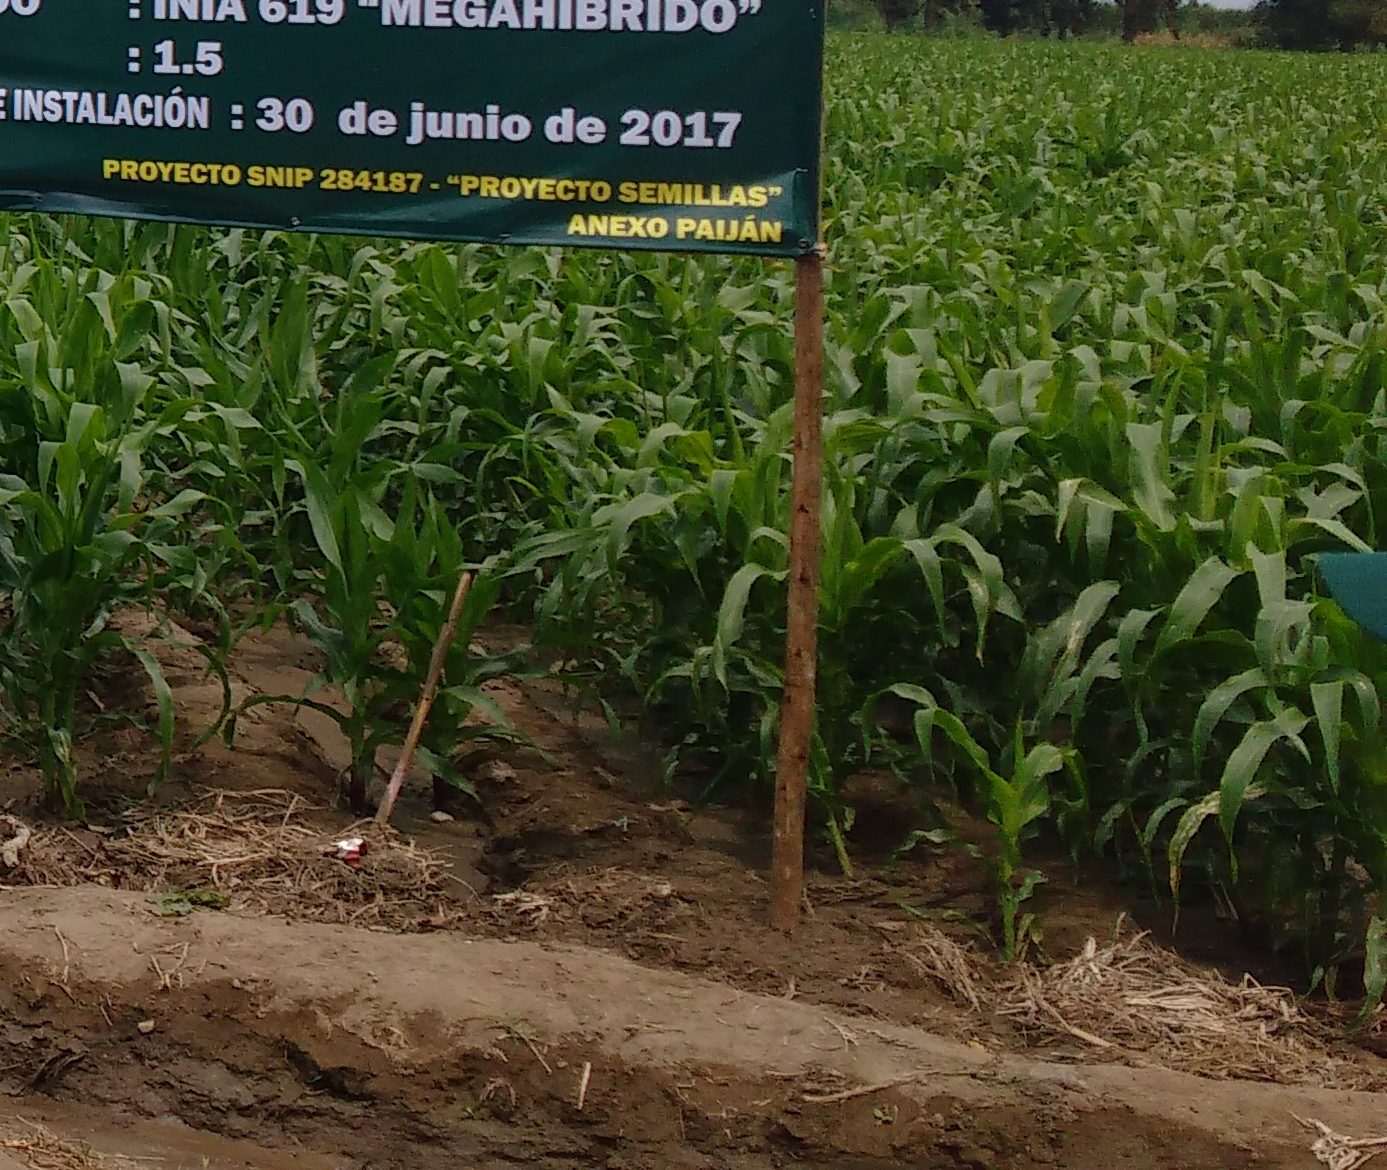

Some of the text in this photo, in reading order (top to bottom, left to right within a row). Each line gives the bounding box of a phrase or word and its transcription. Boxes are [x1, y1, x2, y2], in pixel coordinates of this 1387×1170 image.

[128, 47, 141, 73] :
[154, 39, 223, 76] 1.5
[13, 85, 210, 129] INSTALACIÓN
[231, 104, 244, 130] :
[255, 97, 314, 133] 30
[338, 100, 398, 136] de
[405, 101, 532, 145] junio
[544, 107, 607, 144] de
[619, 109, 743, 148] 2017
[103, 159, 783, 208] PROYECTO SNIP 284187 - “PROYECTO SEMILLAS”
[567, 205, 783, 243] ANEXO PAIJÁN
